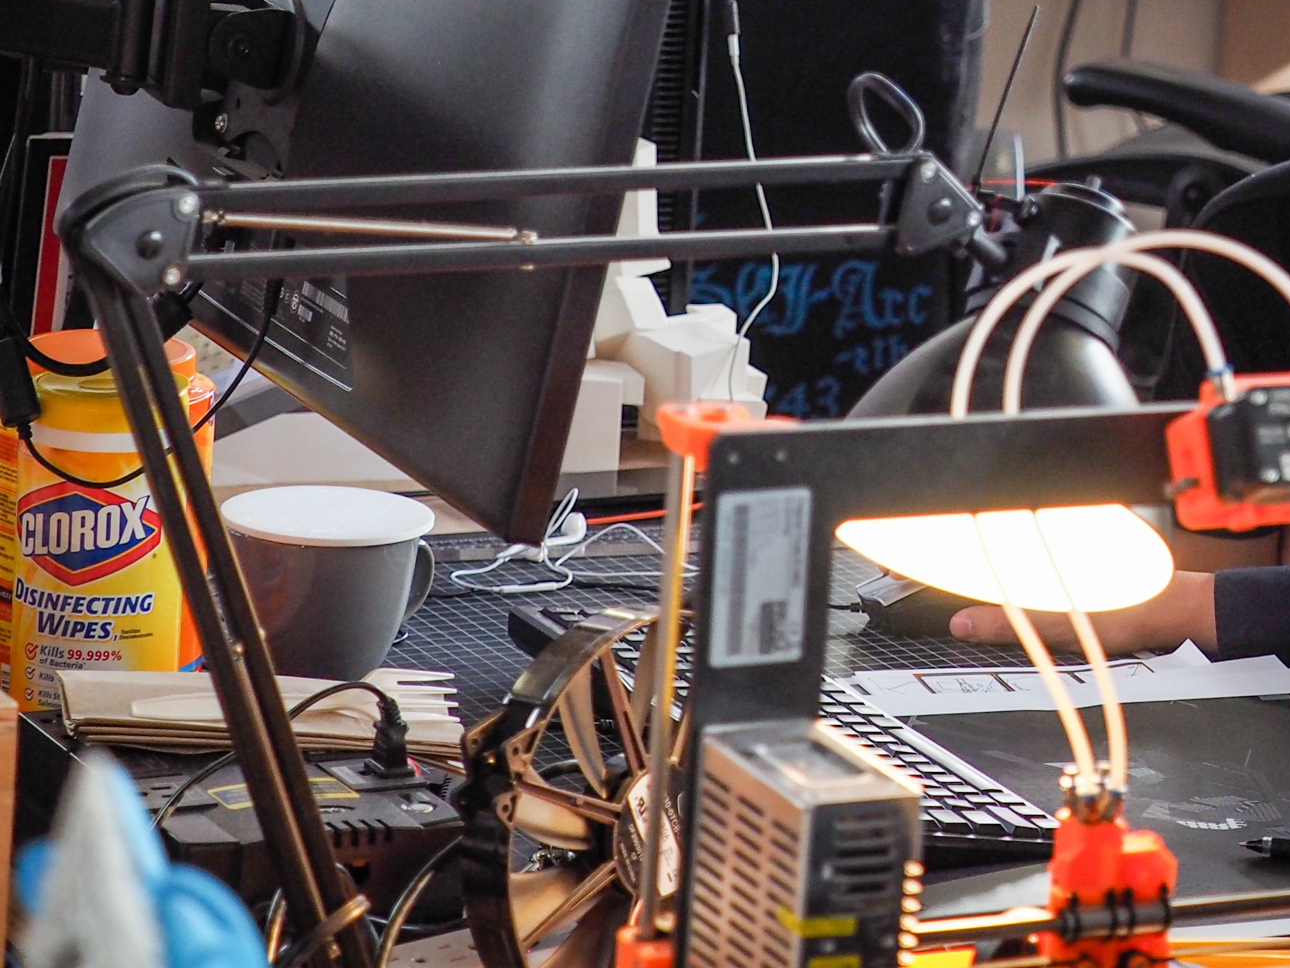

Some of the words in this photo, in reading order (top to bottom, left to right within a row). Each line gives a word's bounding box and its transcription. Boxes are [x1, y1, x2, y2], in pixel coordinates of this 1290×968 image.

[21, 495, 151, 557] CLOROX
[40, 644, 65, 659] Kills
[66, 648, 122, 661] 99.999%
[38, 672, 55, 682] Kills
[38, 690, 53, 699] Kills
